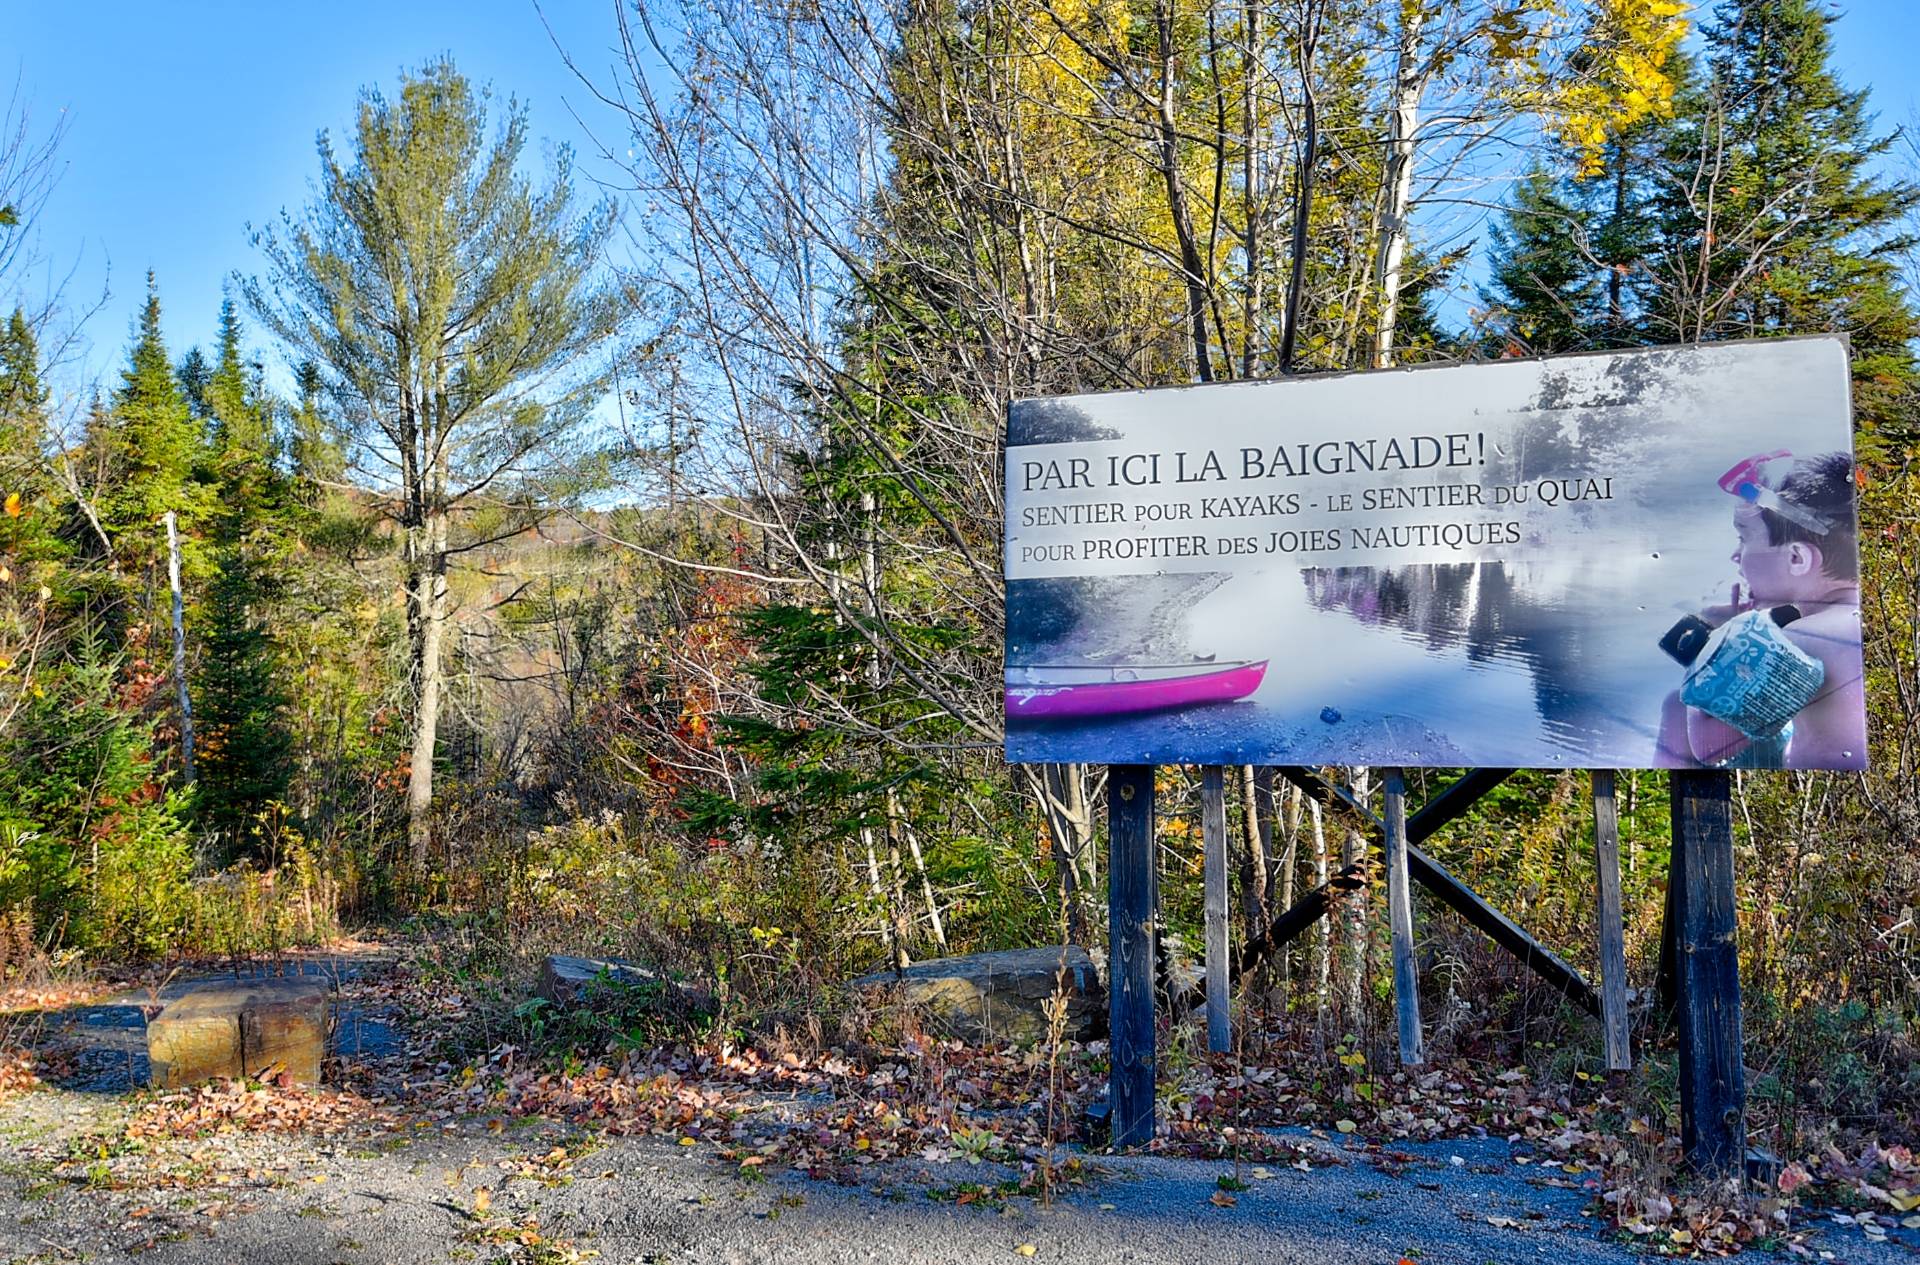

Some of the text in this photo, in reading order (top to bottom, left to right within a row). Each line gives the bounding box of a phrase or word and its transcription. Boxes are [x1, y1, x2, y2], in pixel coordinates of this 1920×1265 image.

[1022, 432, 1485, 491] PAR ICI LA BAIGNADE!
[1022, 502, 1127, 527] SENTIER
[1134, 503, 1193, 522] POUR
[1200, 493, 1300, 519] KAYAKS
[1327, 494, 1353, 512] LE
[1362, 484, 1485, 510] SENTIER
[1494, 485, 1529, 504] DU
[1537, 477, 1613, 506] QUAI
[1022, 522, 1521, 562] POUR PROFITER DES JOIES NAUTIQUES
